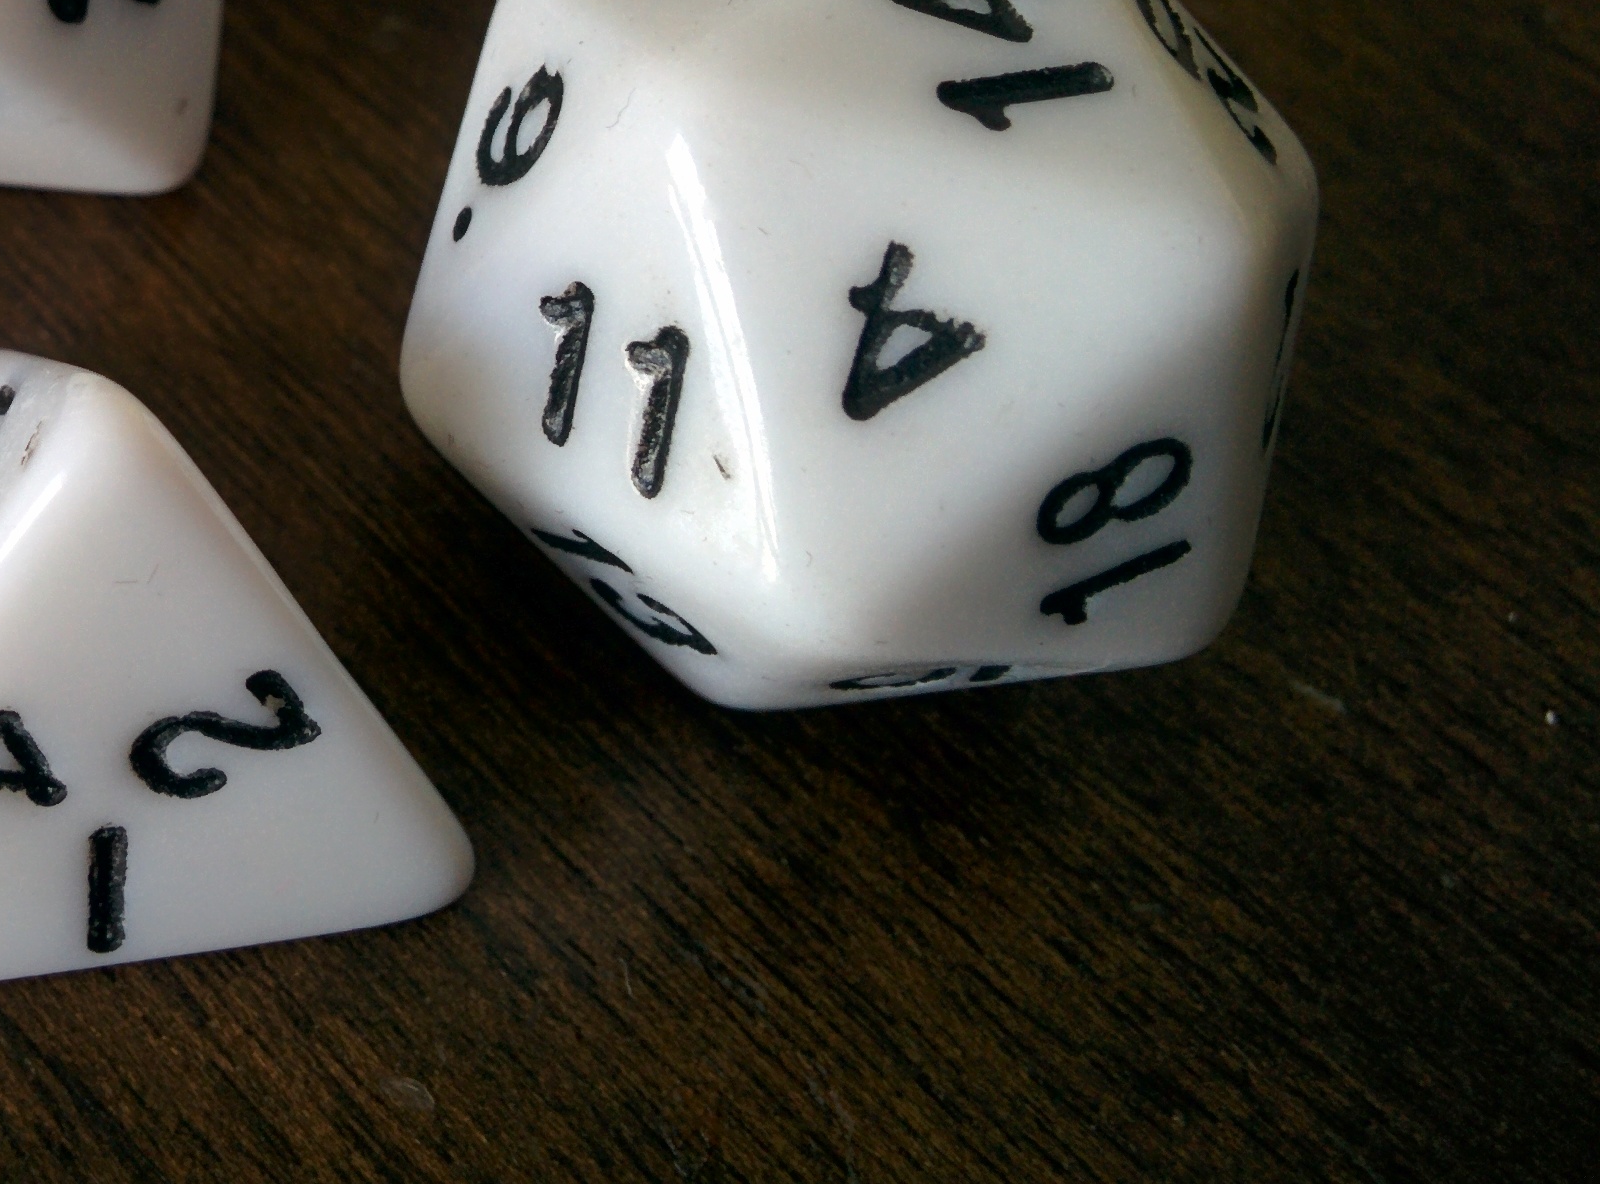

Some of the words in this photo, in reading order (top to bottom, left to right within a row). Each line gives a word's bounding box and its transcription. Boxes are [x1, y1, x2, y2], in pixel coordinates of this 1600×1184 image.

[539, 280, 690, 500] 11
[841, 240, 987, 422] 4
[1036, 437, 1193, 627] 18
[127, 668, 322, 800] 2
[84, 822, 129, 955] 1
